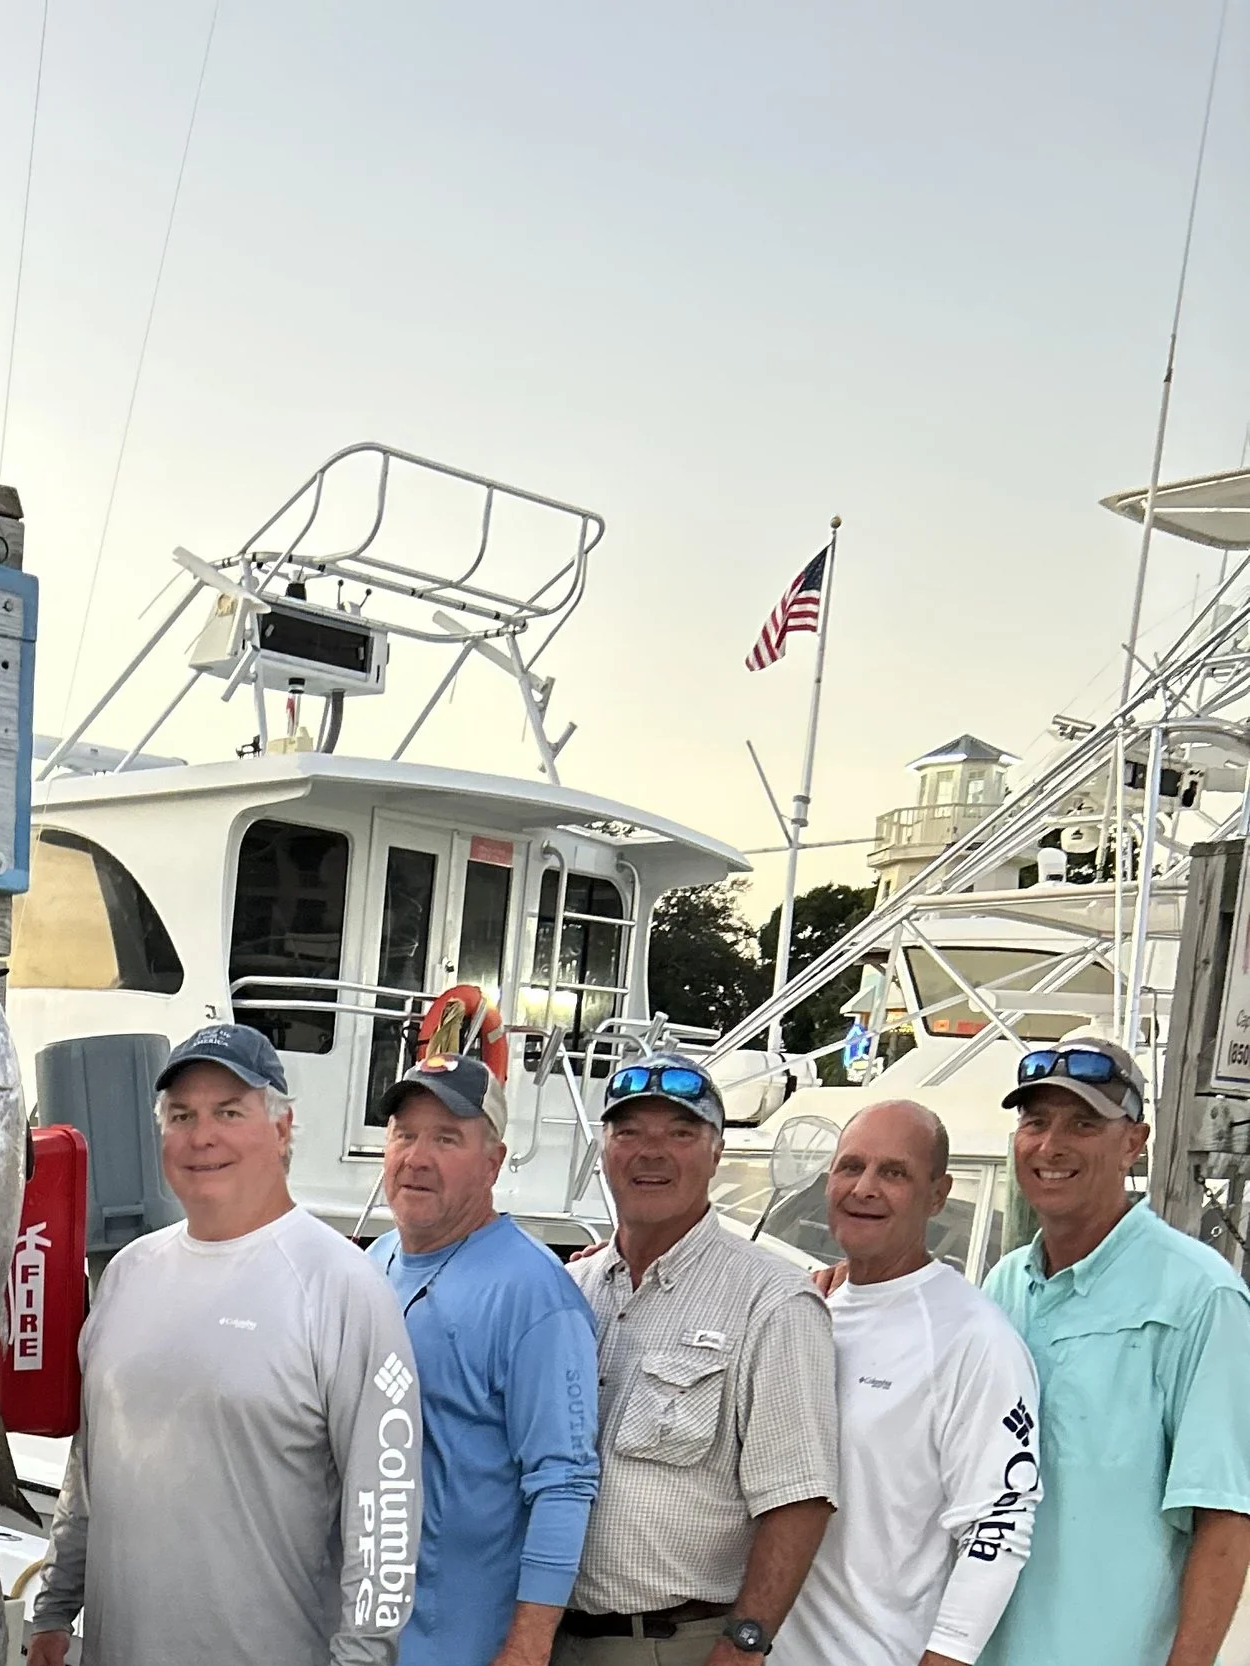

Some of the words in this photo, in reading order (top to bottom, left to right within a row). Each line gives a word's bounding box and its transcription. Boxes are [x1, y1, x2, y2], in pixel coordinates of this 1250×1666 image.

[19, 1264, 40, 1358] FIRE
[354, 1490, 376, 1627] PFG
[376, 1408, 417, 1628] Columbia
